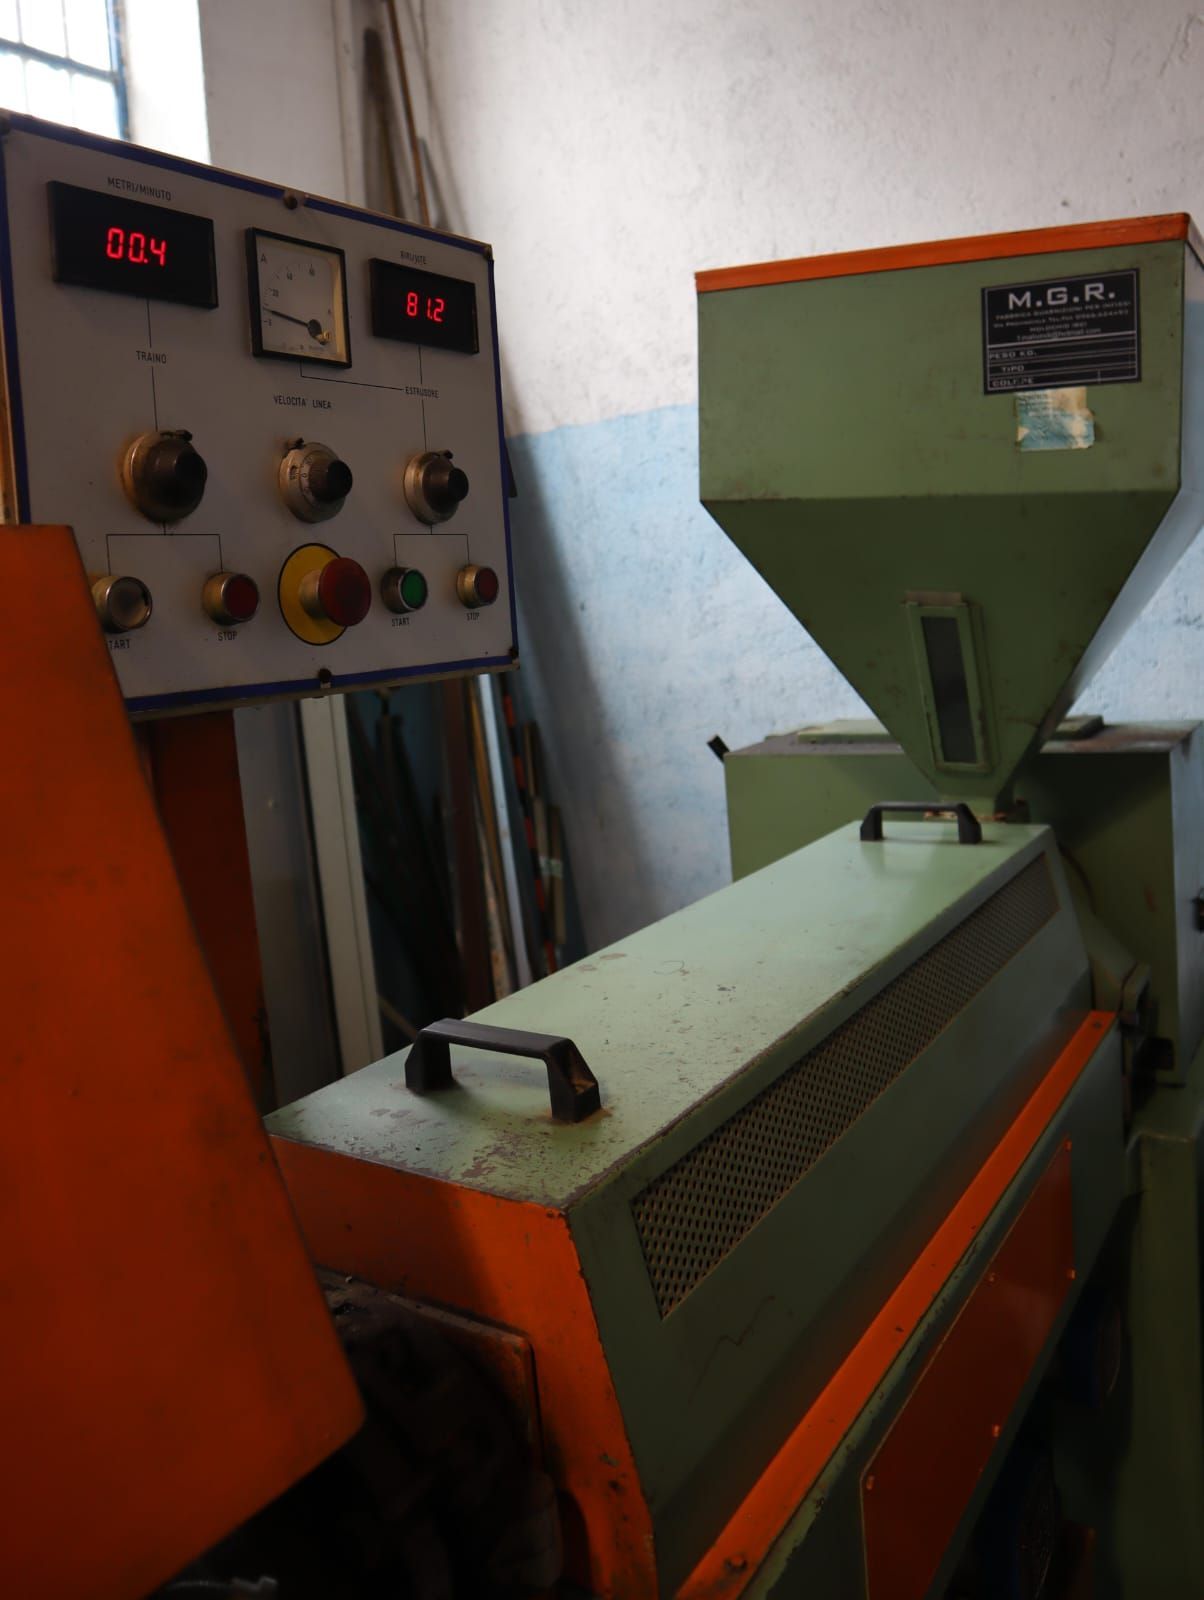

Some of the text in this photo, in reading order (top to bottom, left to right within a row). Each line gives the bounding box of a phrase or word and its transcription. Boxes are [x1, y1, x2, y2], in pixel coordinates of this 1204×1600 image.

[107, 177, 172, 201] METRI/MINUTO
[106, 227, 167, 266] 00.4
[1008, 282, 1116, 311] M.G.R.
[406, 292, 445, 323] 81.2
[136, 350, 167, 365] TRAINO
[405, 386, 440, 399] ESTRUSORE
[312, 399, 332, 410] LINEA
[391, 616, 410, 628] START
[466, 612, 480, 621] STOP
[217, 631, 238, 642] STOP
[108, 638, 131, 649] TART
